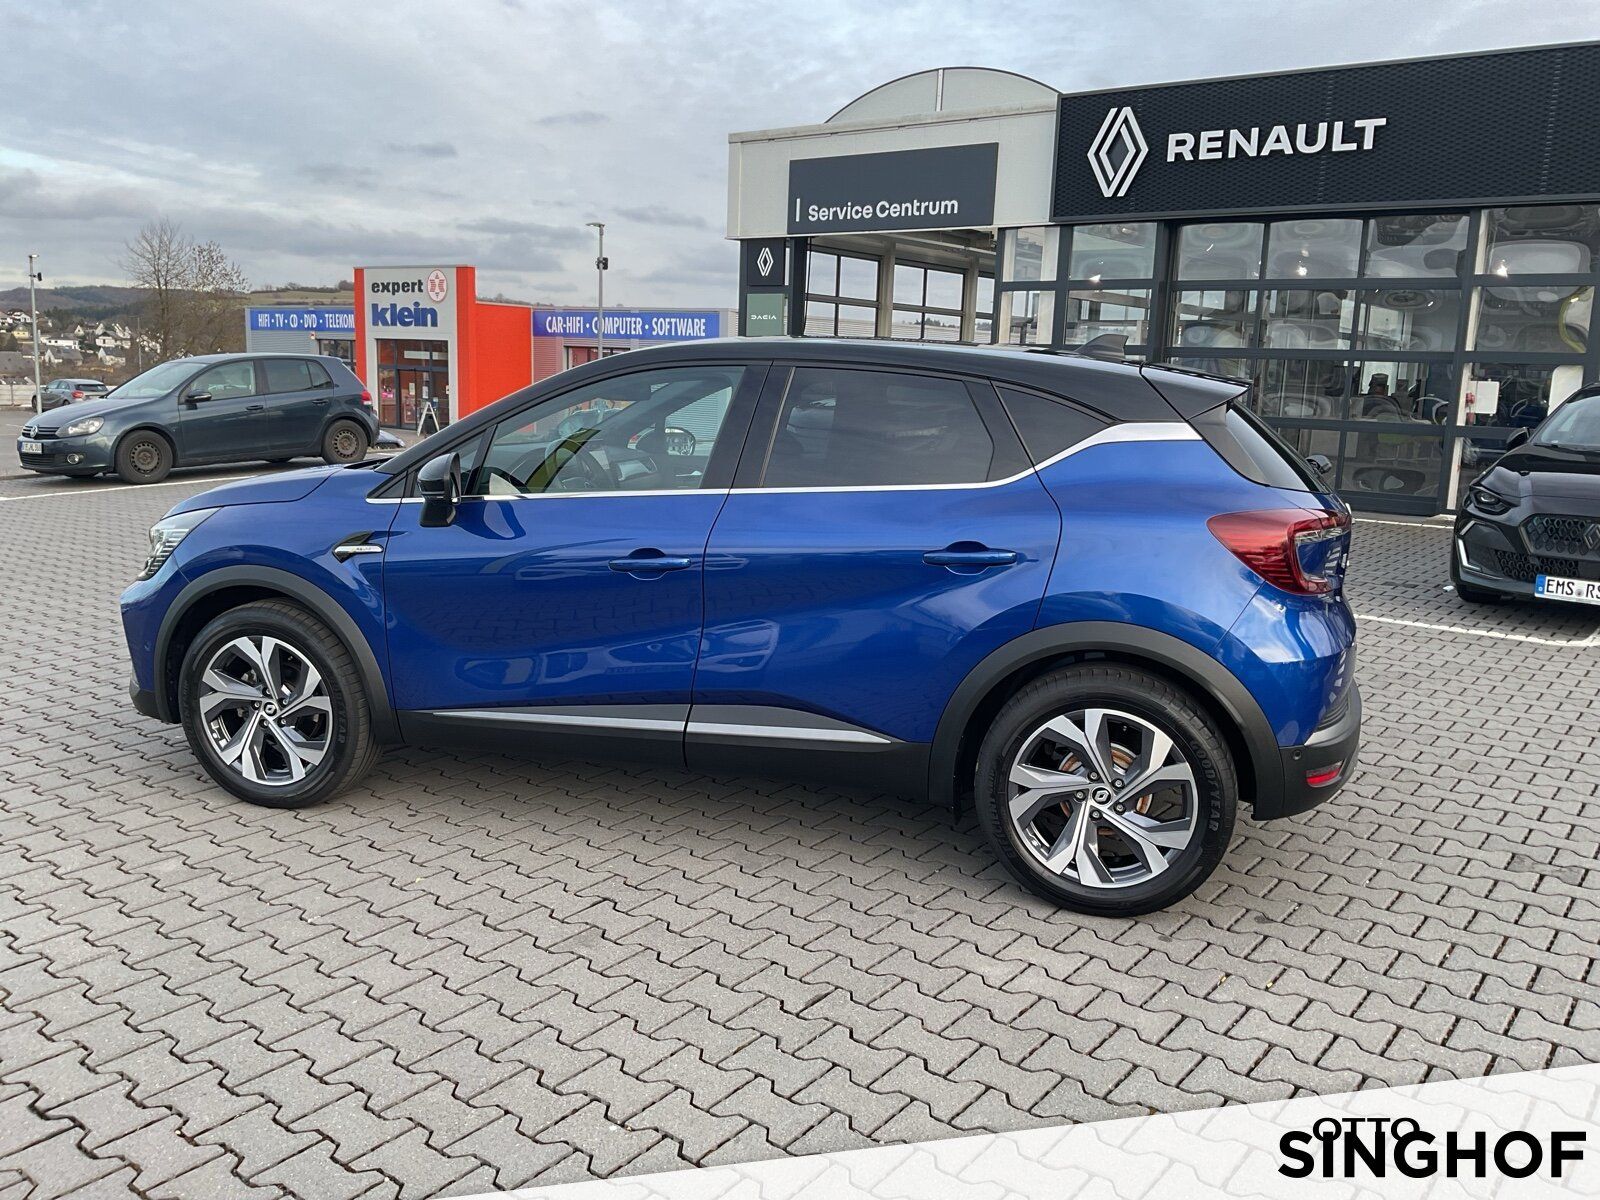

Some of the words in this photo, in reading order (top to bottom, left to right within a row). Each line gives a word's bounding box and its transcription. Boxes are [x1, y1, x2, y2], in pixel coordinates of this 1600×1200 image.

[1166, 117, 1387, 163] RENAULT
[808, 201, 873, 222] Service
[876, 199, 958, 218] Centrum
[371, 279, 424, 295] expert
[258, 313, 270, 327] HIFI
[275, 313, 284, 328] TV
[289, 313, 298, 328] CD
[303, 313, 317, 328] DVD
[324, 313, 355, 328] TELEKOM
[371, 301, 438, 327] klein
[545, 316, 584, 334] CAR-HIFI
[592, 316, 643, 335] COMPUTER
[652, 318, 706, 337] SOFTWARE
[1546, 579, 1574, 595] EMS
